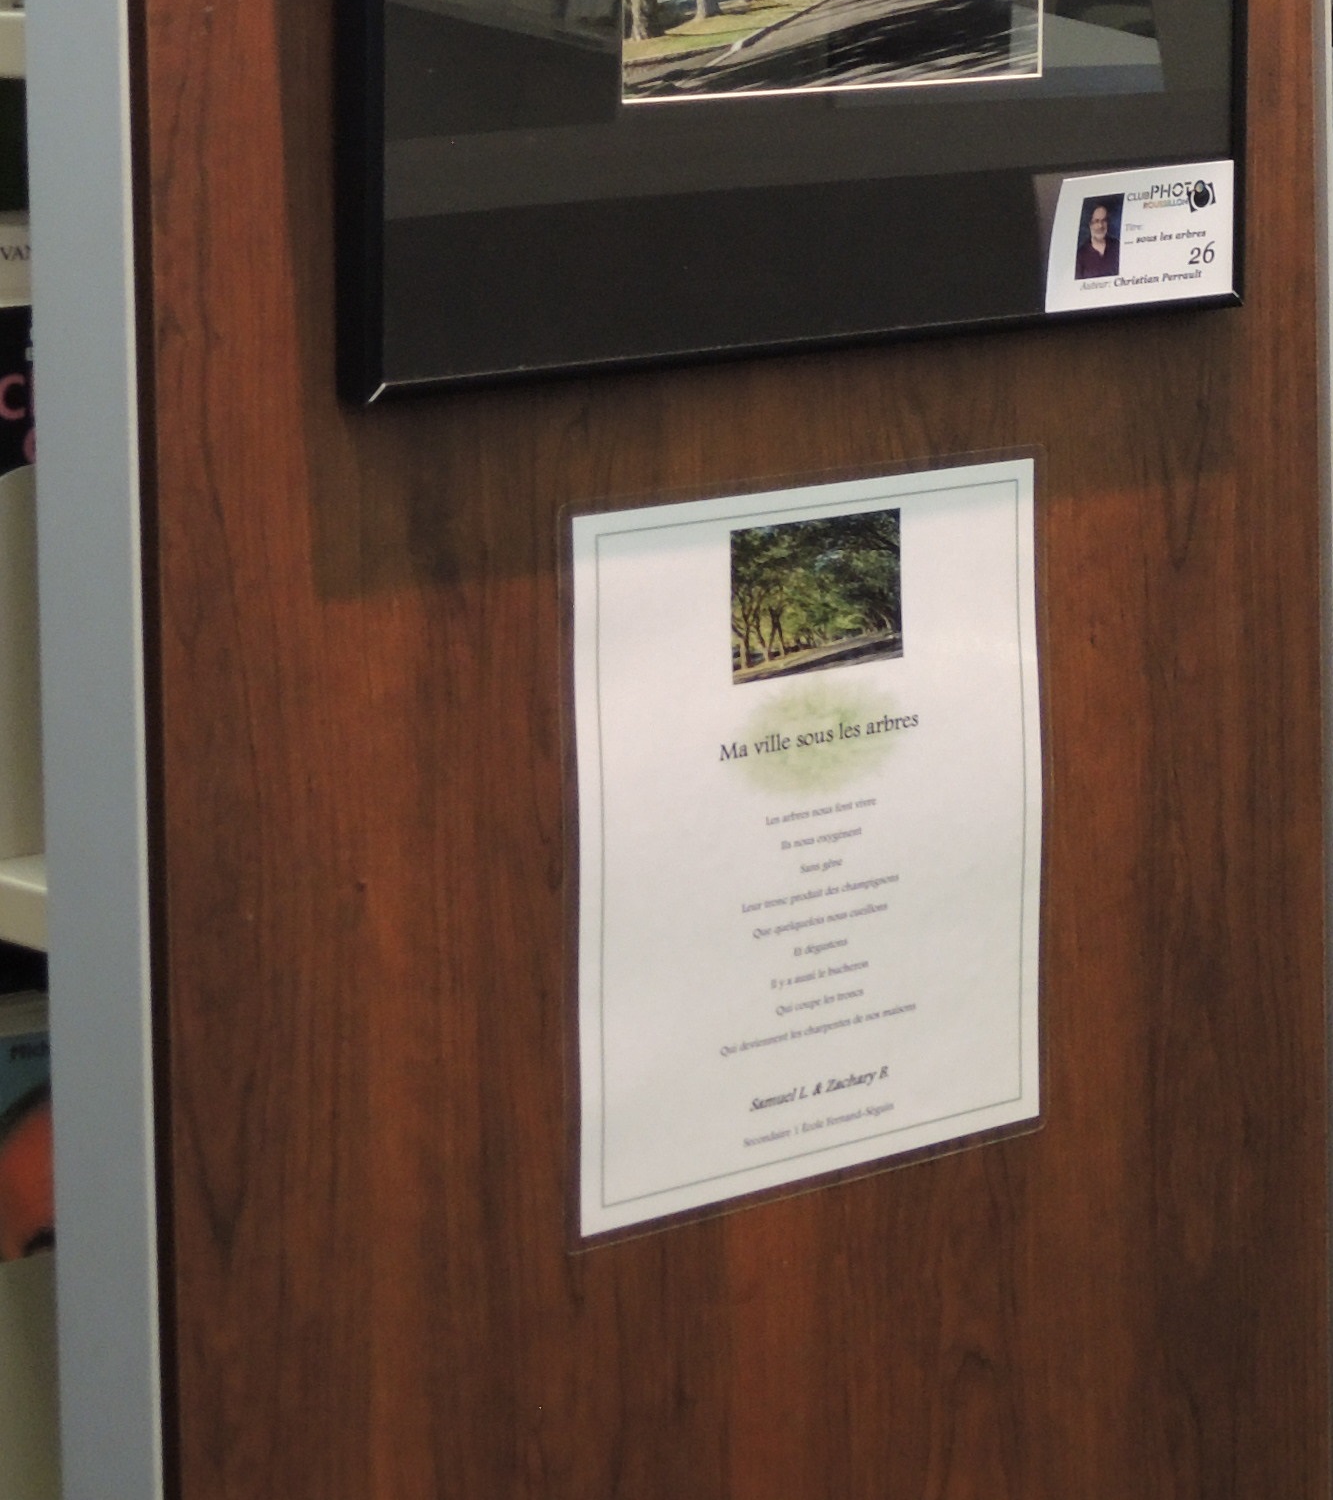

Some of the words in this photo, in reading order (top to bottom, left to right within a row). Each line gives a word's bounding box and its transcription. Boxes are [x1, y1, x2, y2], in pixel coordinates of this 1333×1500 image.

[1136, 234, 1158, 244] sous
[1160, 231, 1173, 241] les
[1175, 229, 1206, 240] arbres
[1187, 240, 1216, 266] 26
[1113, 274, 1160, 288] Christian
[1162, 269, 1203, 283] Perrault
[718, 741, 750, 763] Ma
[753, 734, 791, 756] ville
[796, 728, 834, 750] sous
[838, 721, 862, 742] les
[866, 712, 920, 736] arbres
[825, 1071, 877, 1094] Zachary
